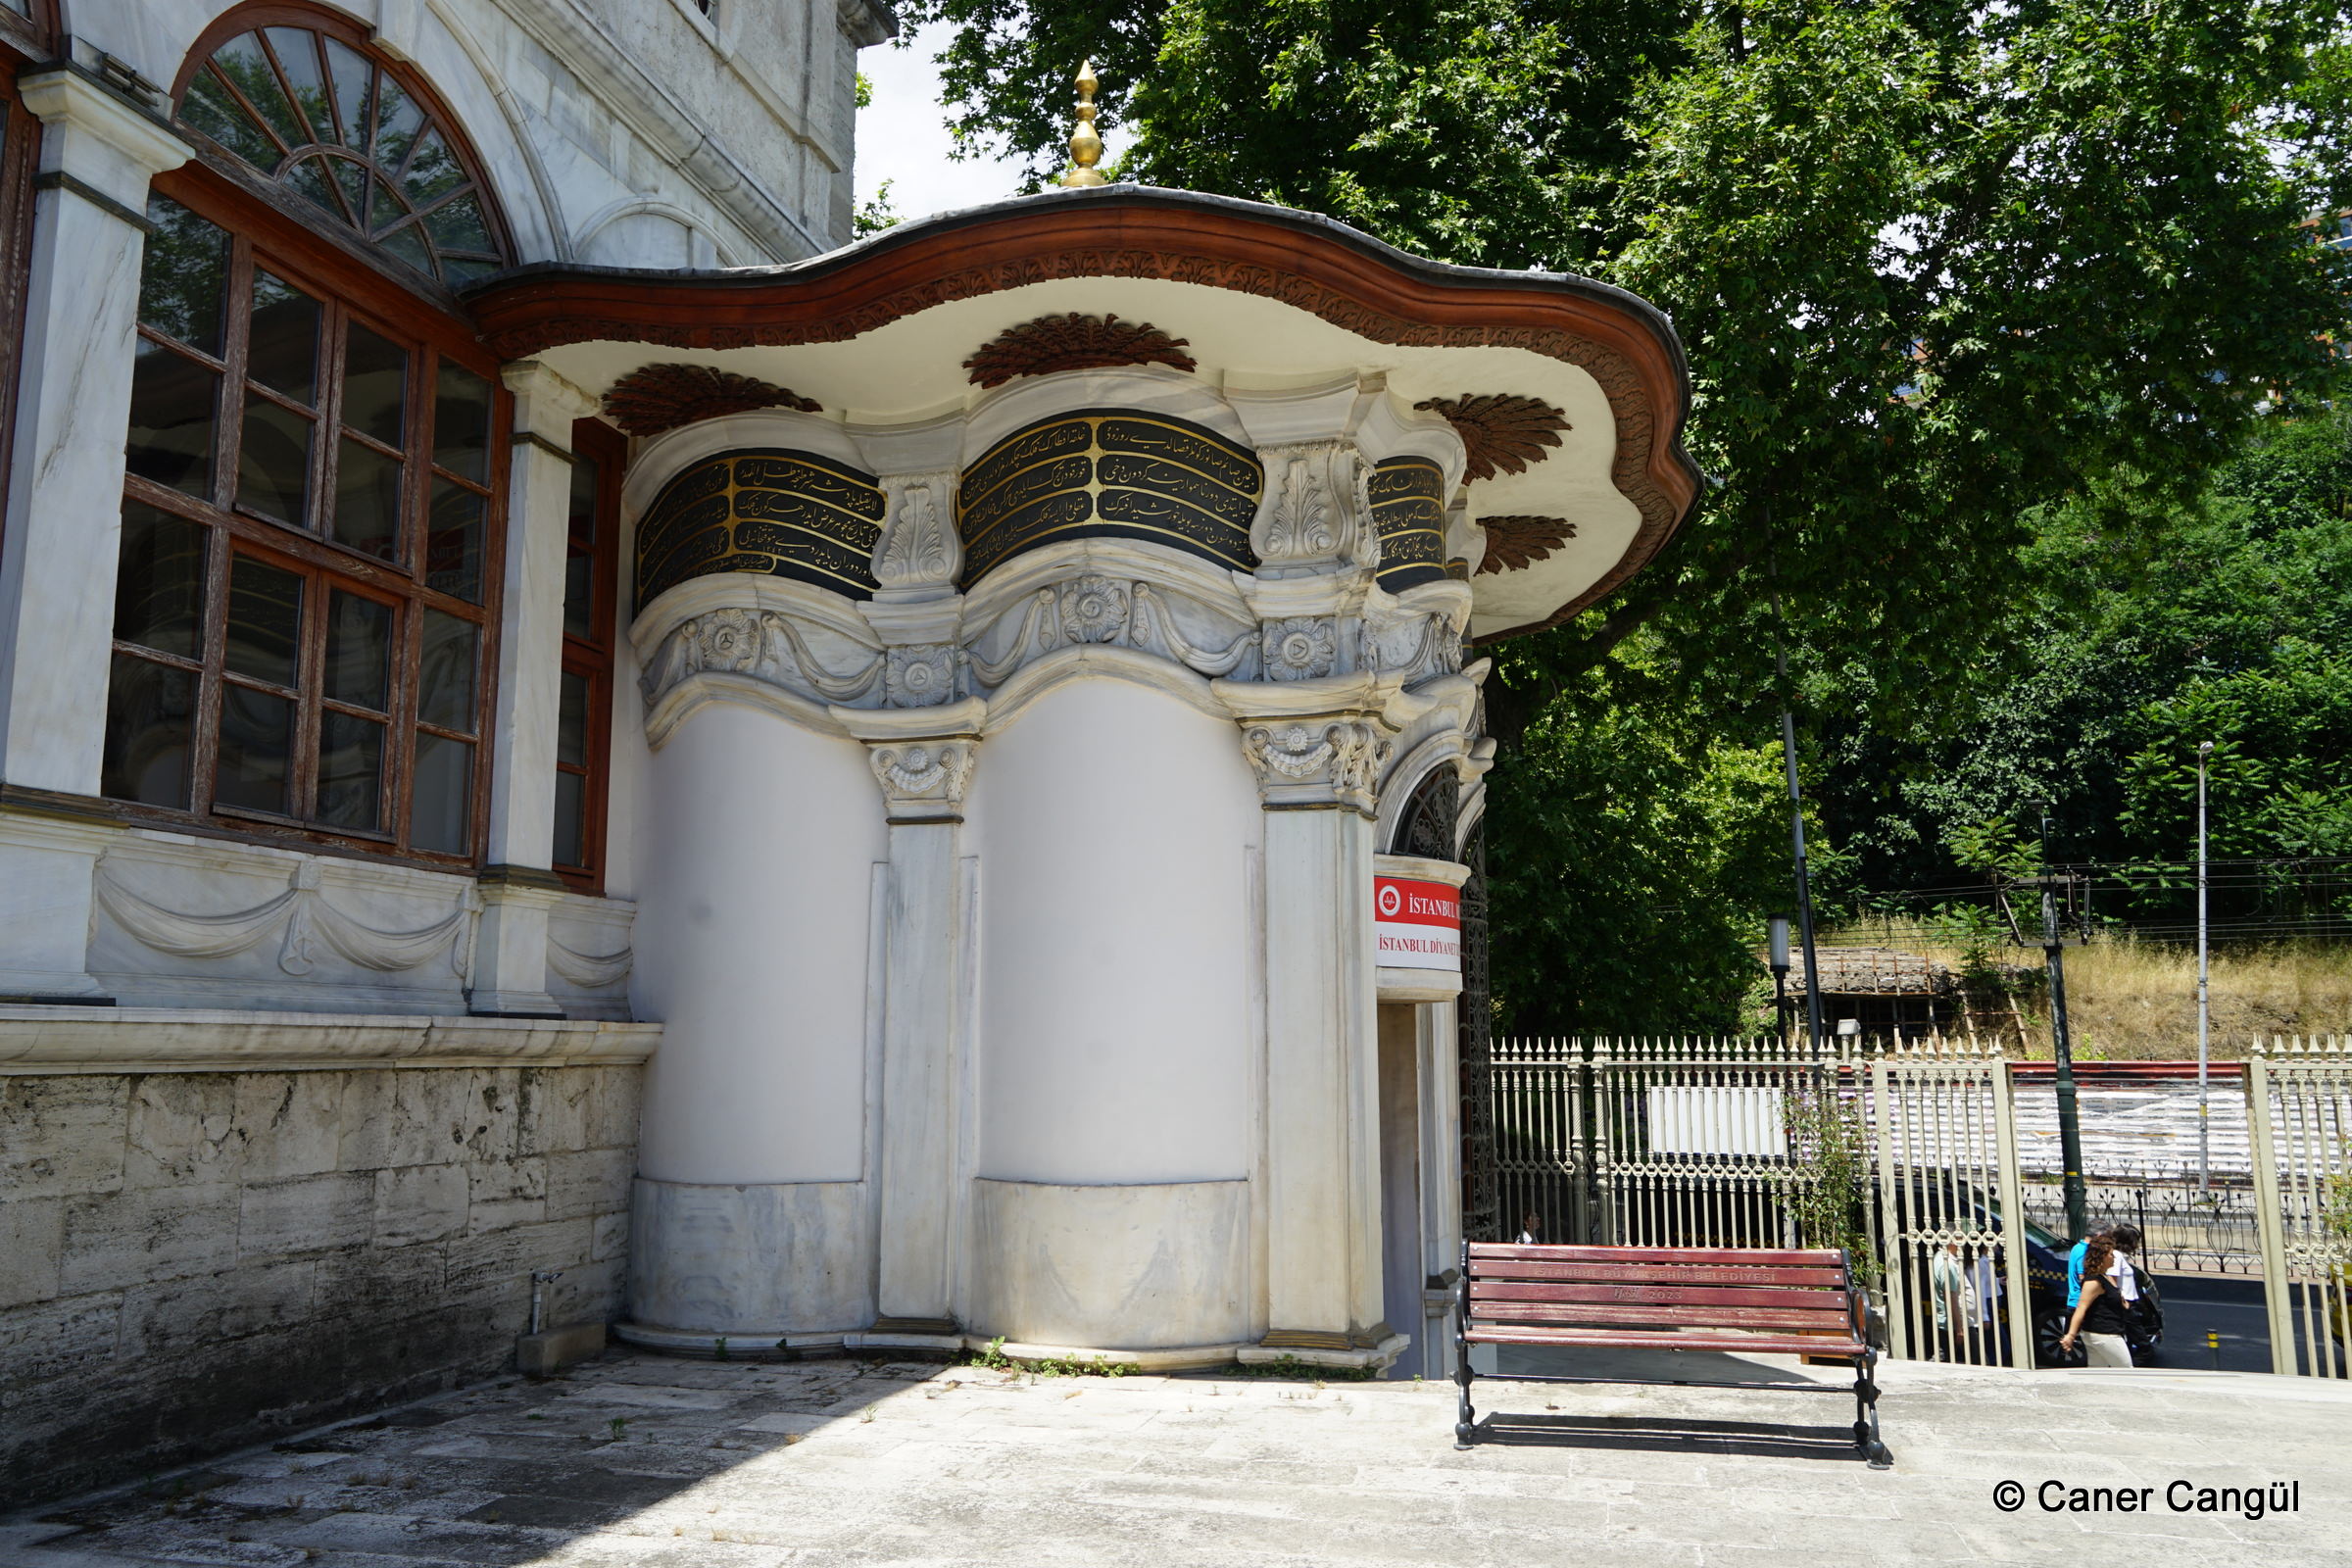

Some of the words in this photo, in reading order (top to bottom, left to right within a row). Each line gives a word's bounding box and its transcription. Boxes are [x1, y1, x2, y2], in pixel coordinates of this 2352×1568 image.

[1409, 893, 1454, 918] İSTANBUL
[1379, 934, 1429, 953] İSTANBUL
[1693, 1269, 1776, 1282] BELEDİYESİ
